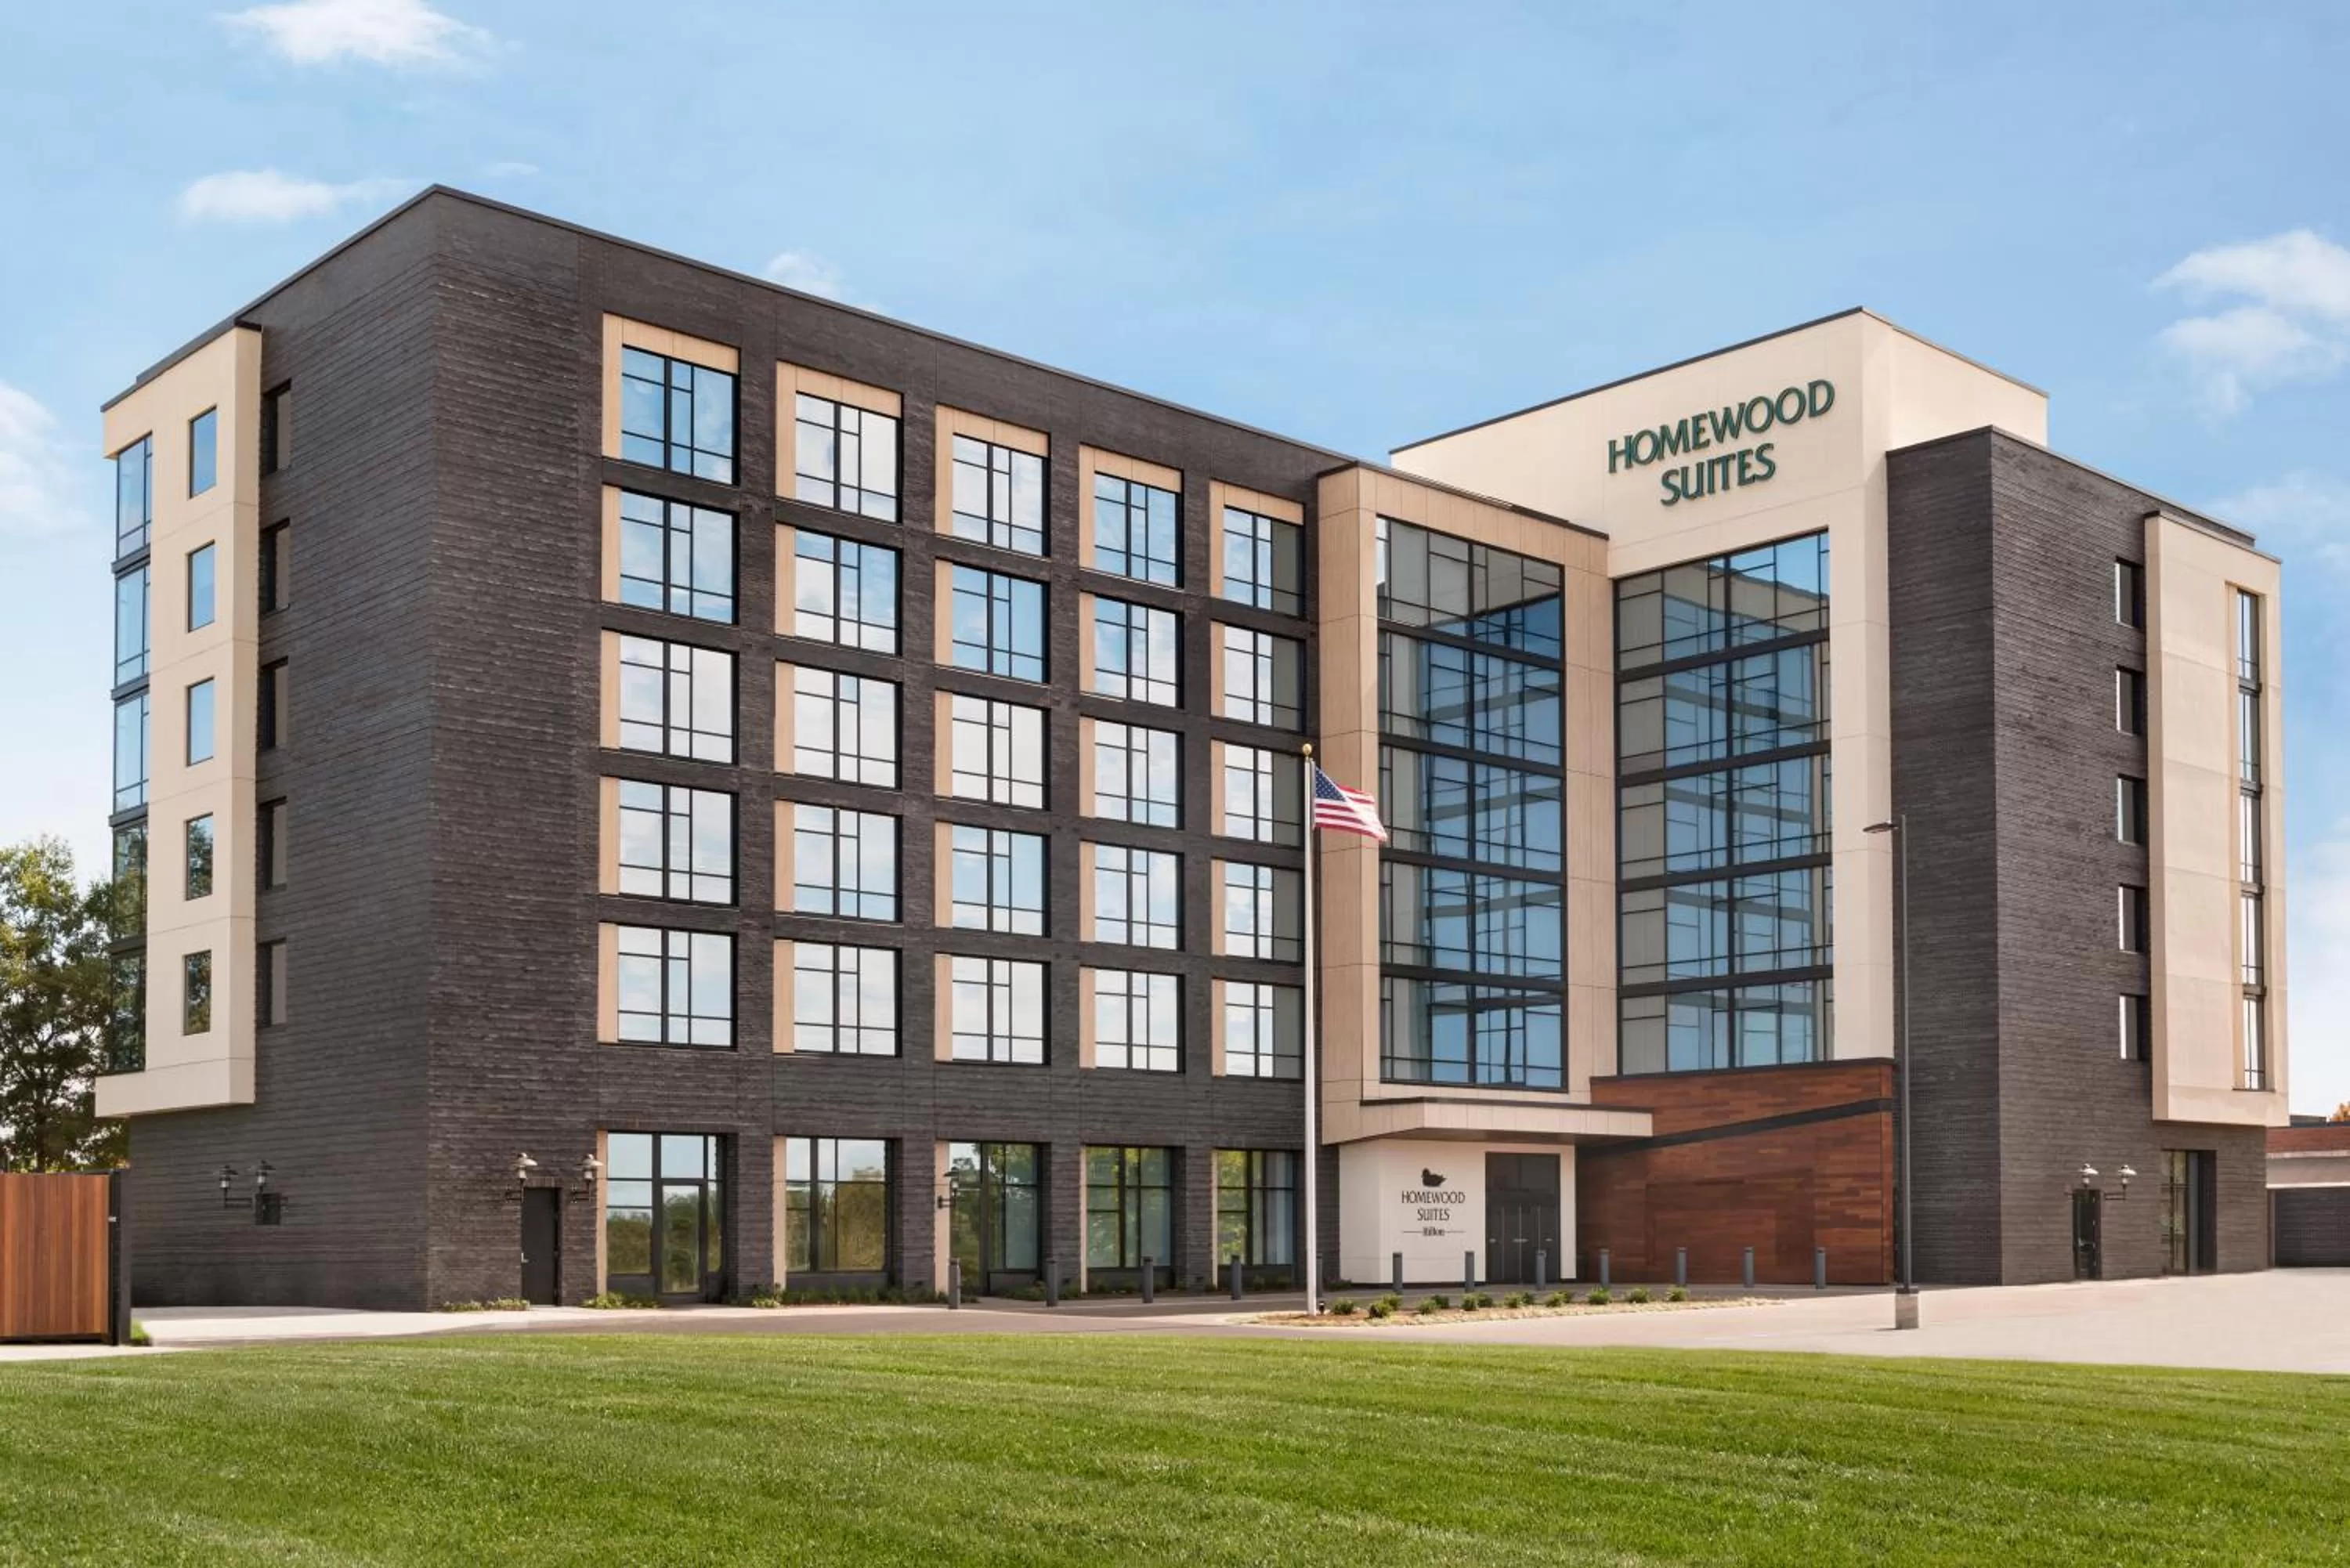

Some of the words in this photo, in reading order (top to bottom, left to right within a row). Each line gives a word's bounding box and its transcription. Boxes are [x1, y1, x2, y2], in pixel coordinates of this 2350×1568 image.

[1608, 379, 1835, 474] HOMEWOOD
[1660, 443, 1776, 507] SUITES
[1401, 1190, 1466, 1204] HOMEWOOD
[1417, 1208, 1451, 1221] SUITES
